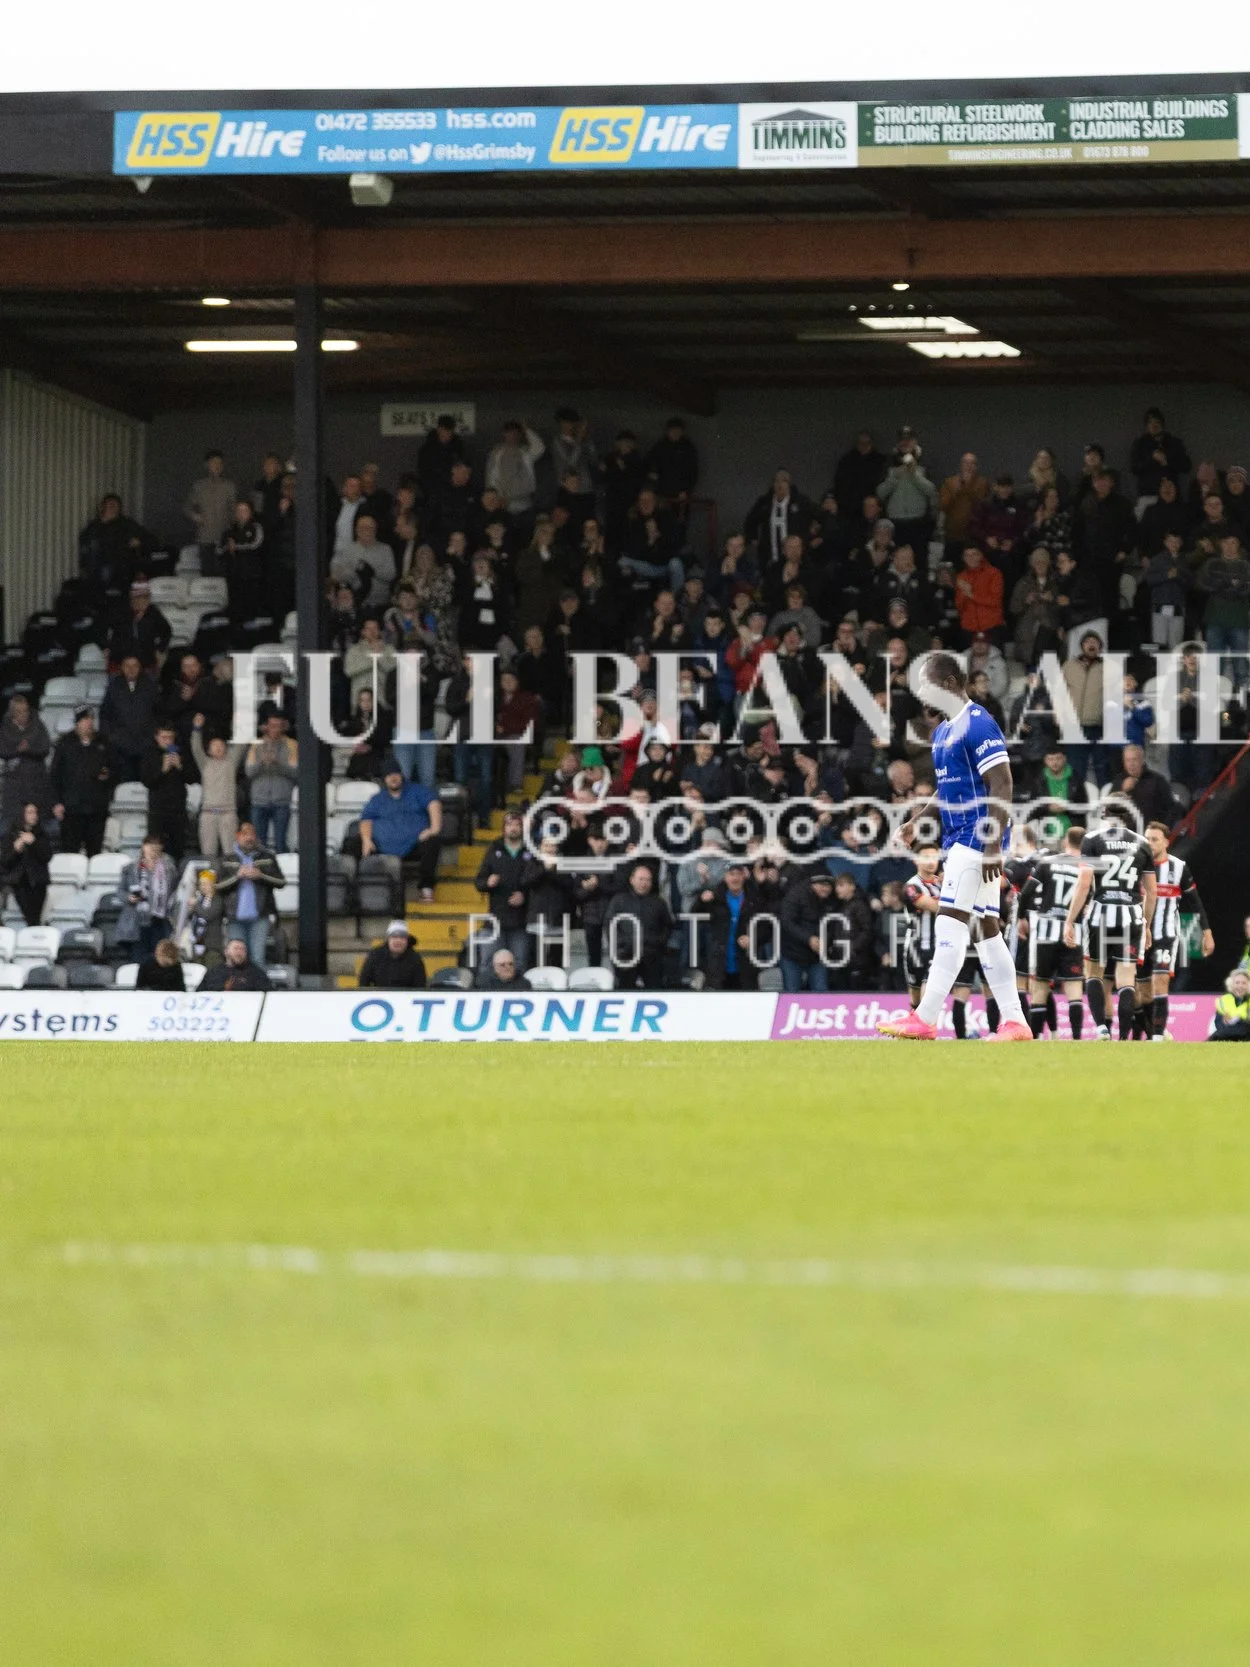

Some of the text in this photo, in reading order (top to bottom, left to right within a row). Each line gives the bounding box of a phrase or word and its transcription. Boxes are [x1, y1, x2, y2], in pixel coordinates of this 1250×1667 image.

[446, 109, 537, 129] hss.com
[873, 103, 1045, 124] STRUCTURAL STEELWORK
[1069, 99, 1229, 120] INDUSTRIAL BUILDINGS
[315, 111, 437, 132] 01472 355533
[874, 121, 1056, 144] BUILDING REFURBISHMENT
[1069, 119, 1185, 140] CLADDING SALES
[135, 123, 211, 158] HSS
[215, 121, 306, 157] Hire
[559, 118, 634, 152] HSS
[638, 115, 732, 152] Hire
[318, 145, 409, 163] Follow us on
[434, 142, 537, 164] @HssGrimsby
[1100, 854, 1138, 889] 24
[1052, 873, 1079, 906] 17
[1156, 948, 1171, 964] 16
[351, 998, 669, 1033] O.TURNER
[780, 1002, 849, 1035] Just
[855, 1001, 911, 1031] the
